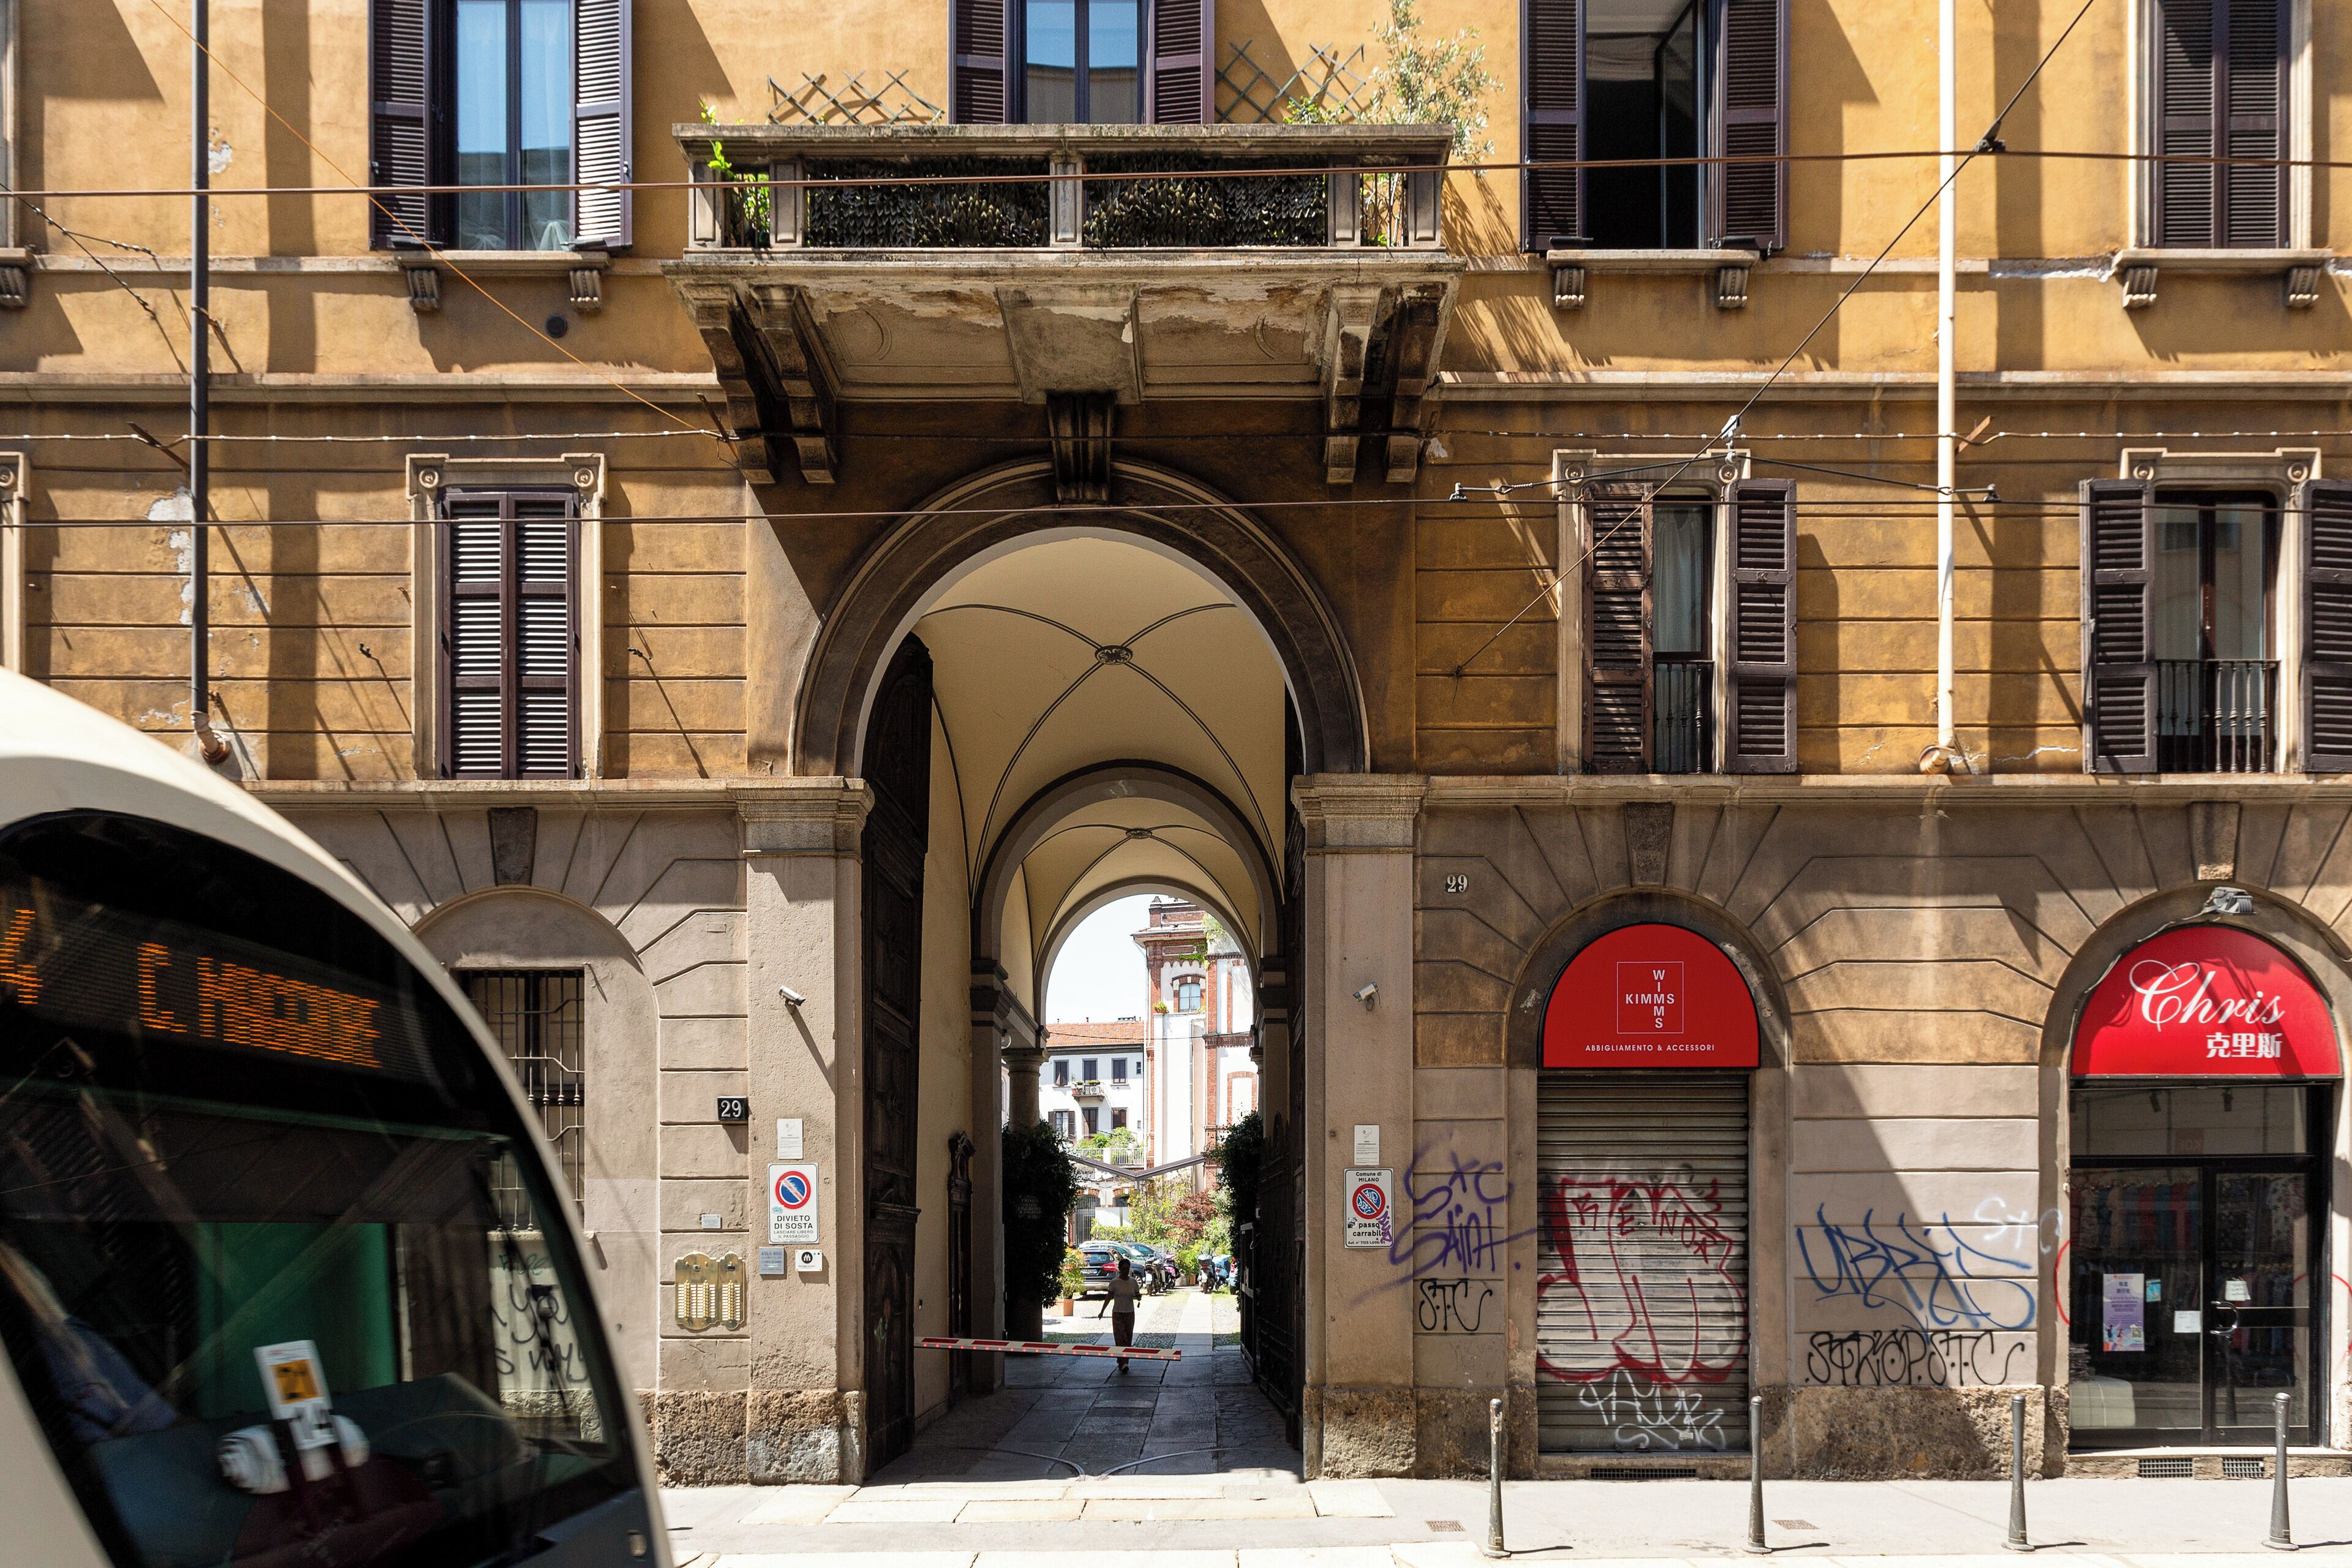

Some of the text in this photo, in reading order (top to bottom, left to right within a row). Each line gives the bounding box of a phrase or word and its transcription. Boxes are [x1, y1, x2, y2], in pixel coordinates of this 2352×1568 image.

[1447, 874, 1468, 892] 29
[1626, 993, 1675, 1005] KIMMS
[2129, 959, 2285, 1032] Chris
[2205, 1031, 2283, 1059] 克里斯
[720, 1100, 742, 1118] 29
